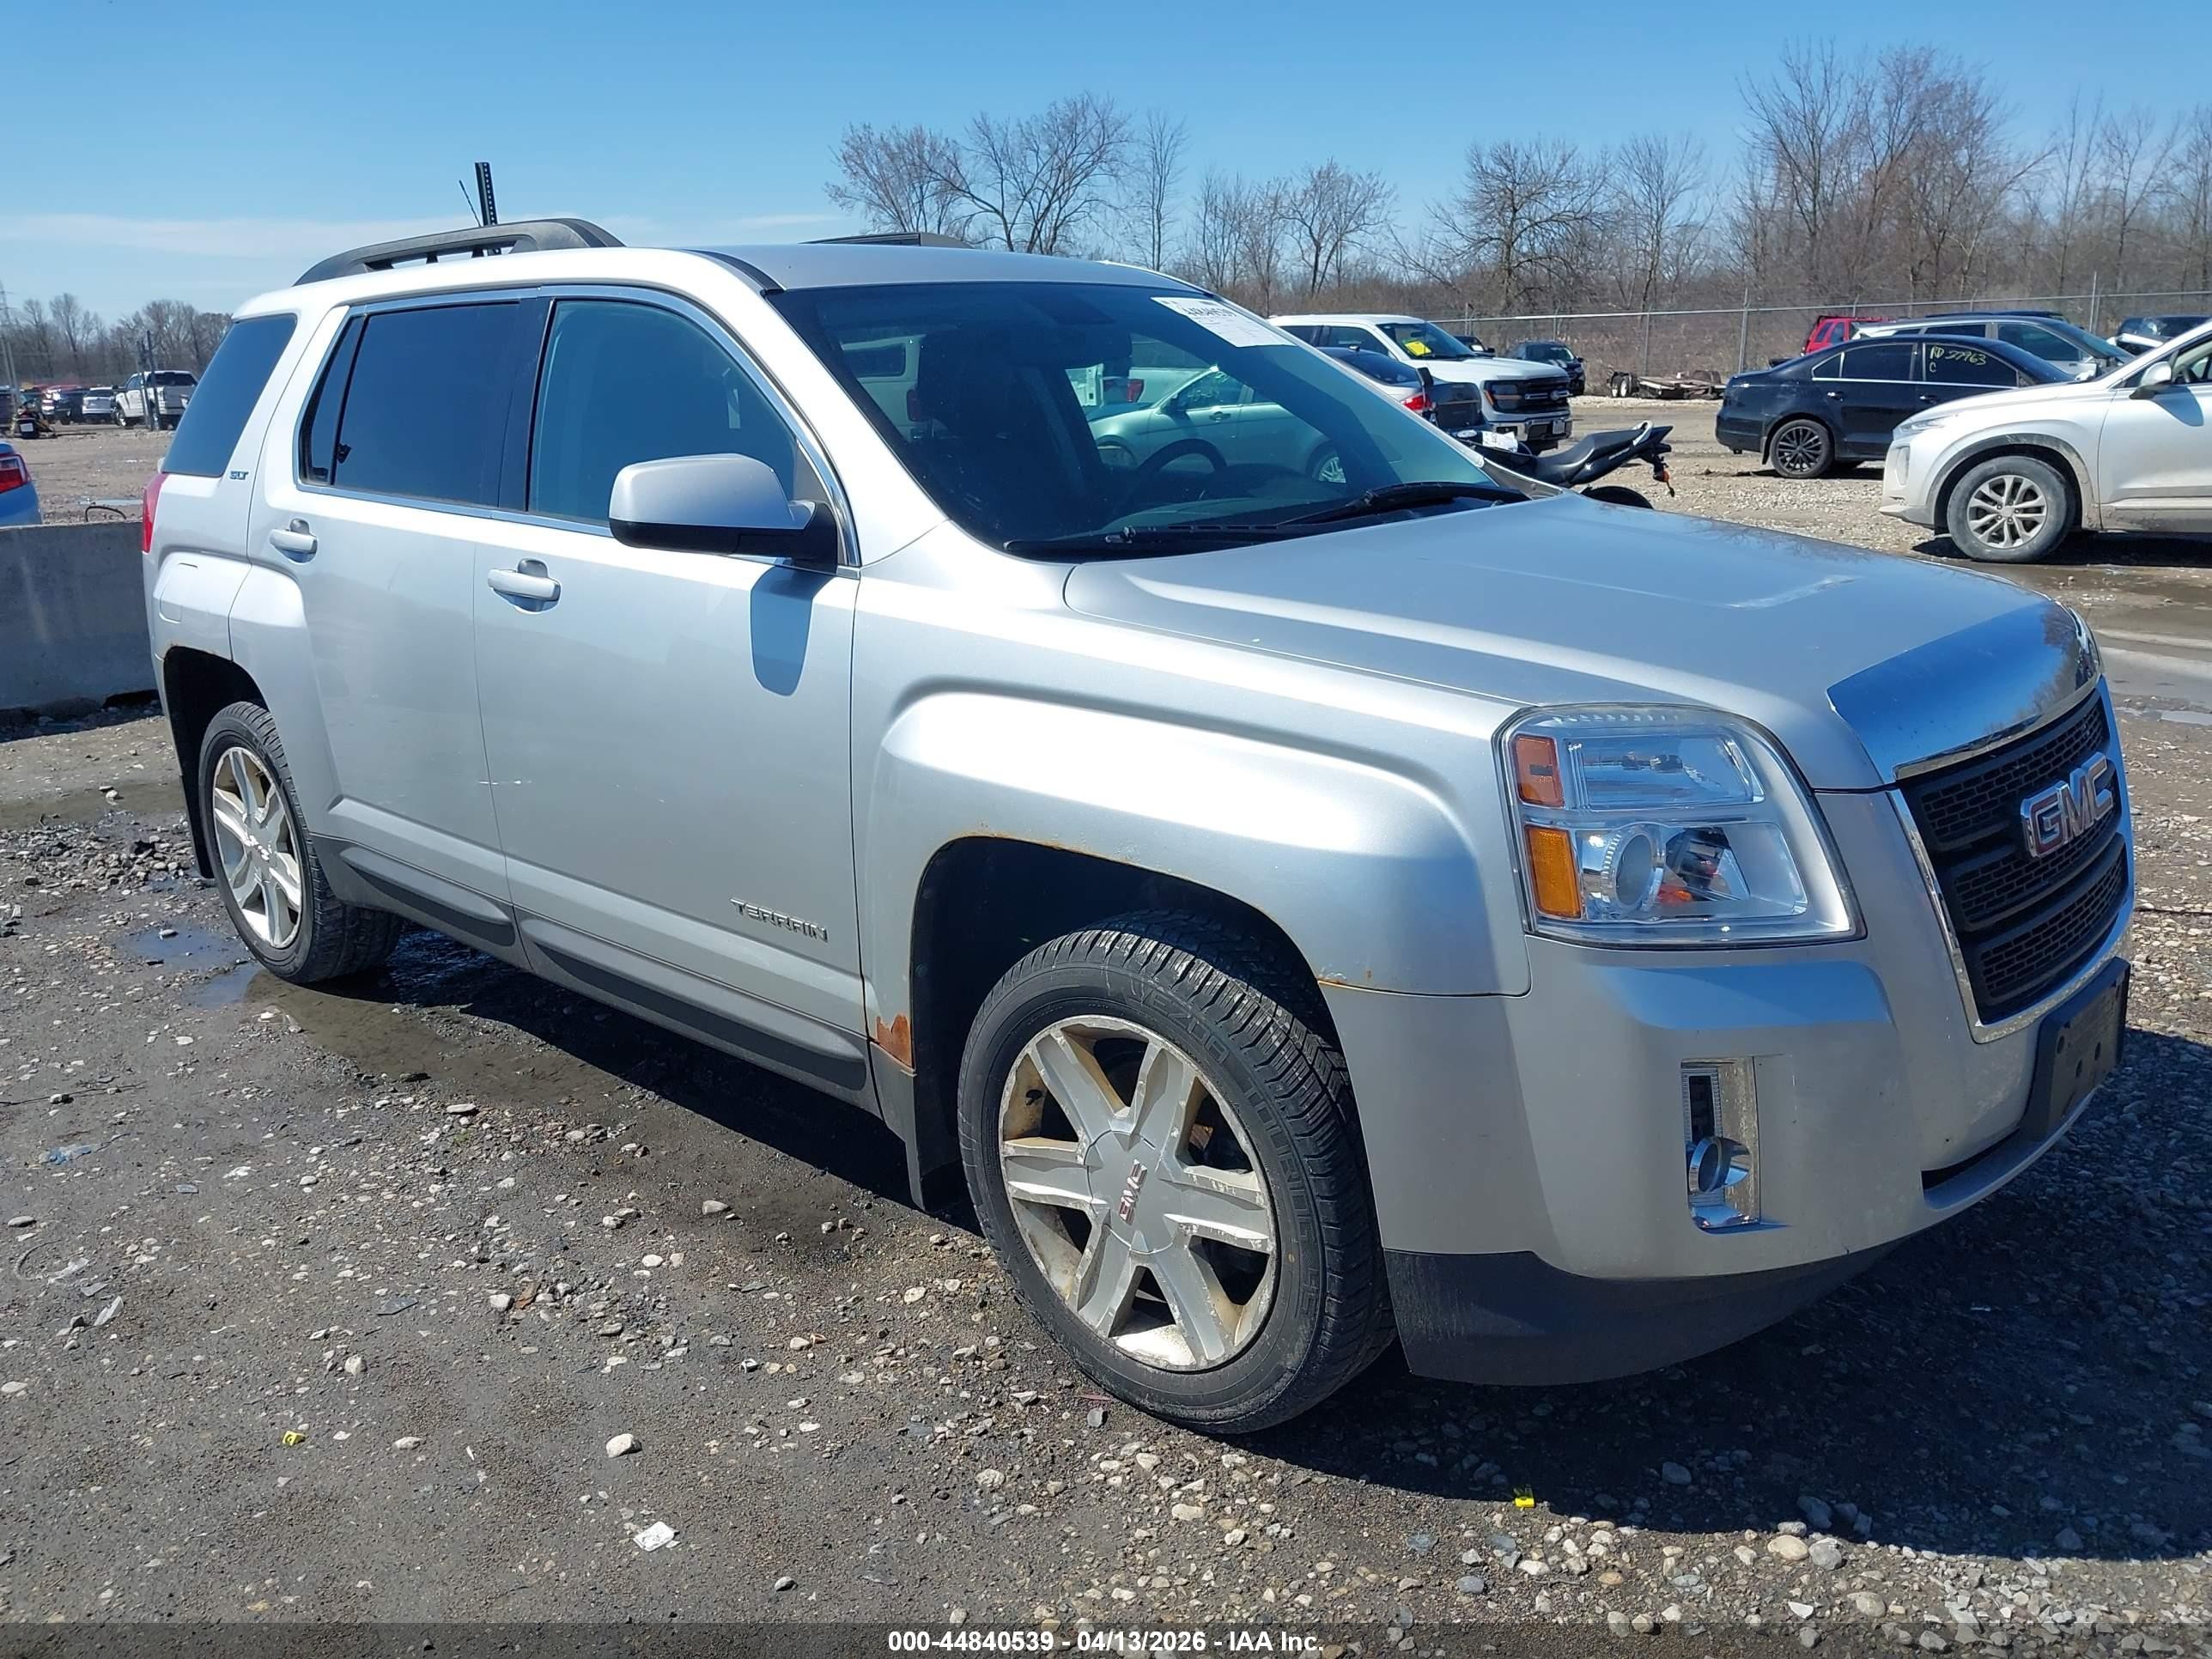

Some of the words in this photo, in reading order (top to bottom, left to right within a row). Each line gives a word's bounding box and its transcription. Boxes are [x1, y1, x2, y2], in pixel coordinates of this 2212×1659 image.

[2021, 752, 2113, 858] GMC
[730, 897, 828, 942] TERRAIN
[1119, 1159, 1147, 1224] GMC
[1244, 1081, 1316, 1239] TOURING
